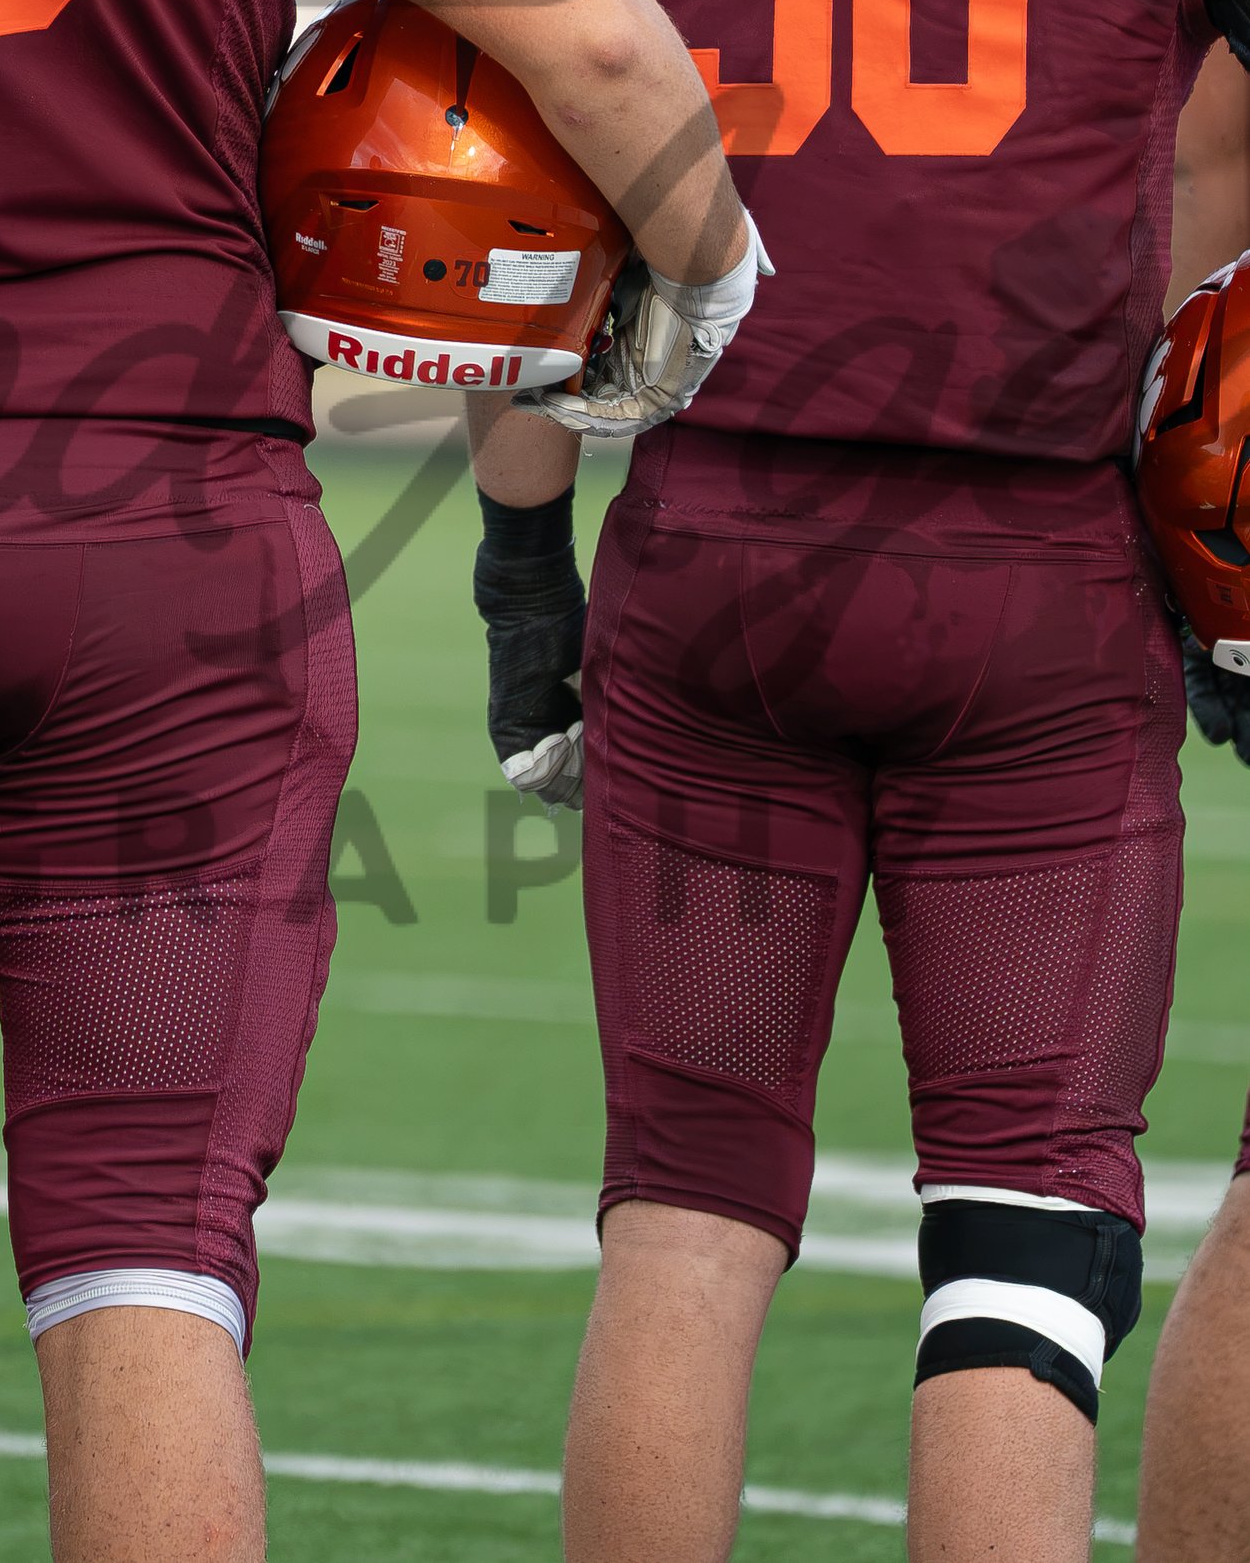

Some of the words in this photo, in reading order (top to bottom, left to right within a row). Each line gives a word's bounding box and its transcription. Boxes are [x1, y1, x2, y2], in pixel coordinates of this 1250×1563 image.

[521, 253, 555, 261] WARNING
[454, 259, 491, 287] 70
[327, 329, 522, 386] Riddell
